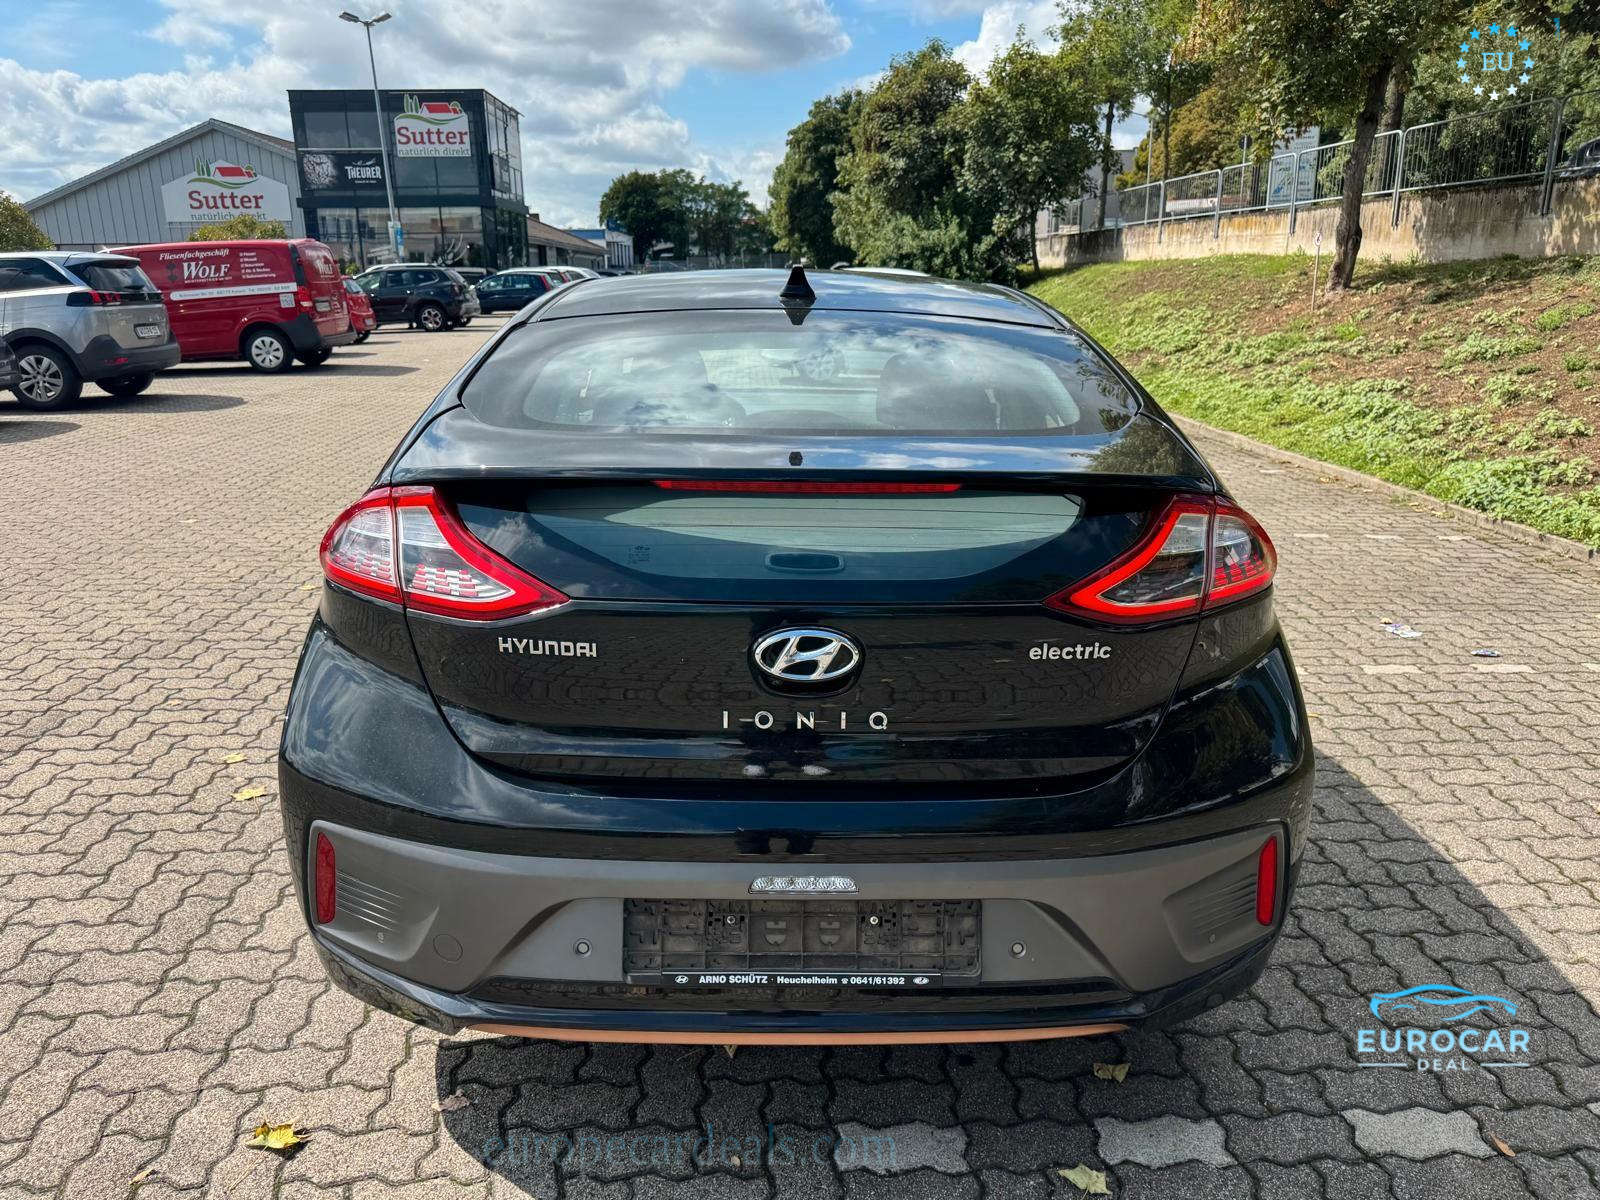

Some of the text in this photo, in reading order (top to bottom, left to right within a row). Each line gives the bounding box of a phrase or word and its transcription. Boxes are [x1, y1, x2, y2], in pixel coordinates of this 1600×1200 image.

[397, 126, 468, 145] Sutter
[442, 146, 470, 156] direkt
[344, 165, 382, 179] THEURER
[188, 190, 264, 209] Sutter
[159, 248, 230, 261] Fliesenfachgeschäft
[182, 260, 230, 280] WOLF
[498, 636, 598, 658] HYUNDAI
[1029, 641, 1112, 660] electric
[722, 710, 889, 731] IONIQ
[699, 973, 905, 985] ARNO SCHÜTZ Heuchelheim 0641/61392
